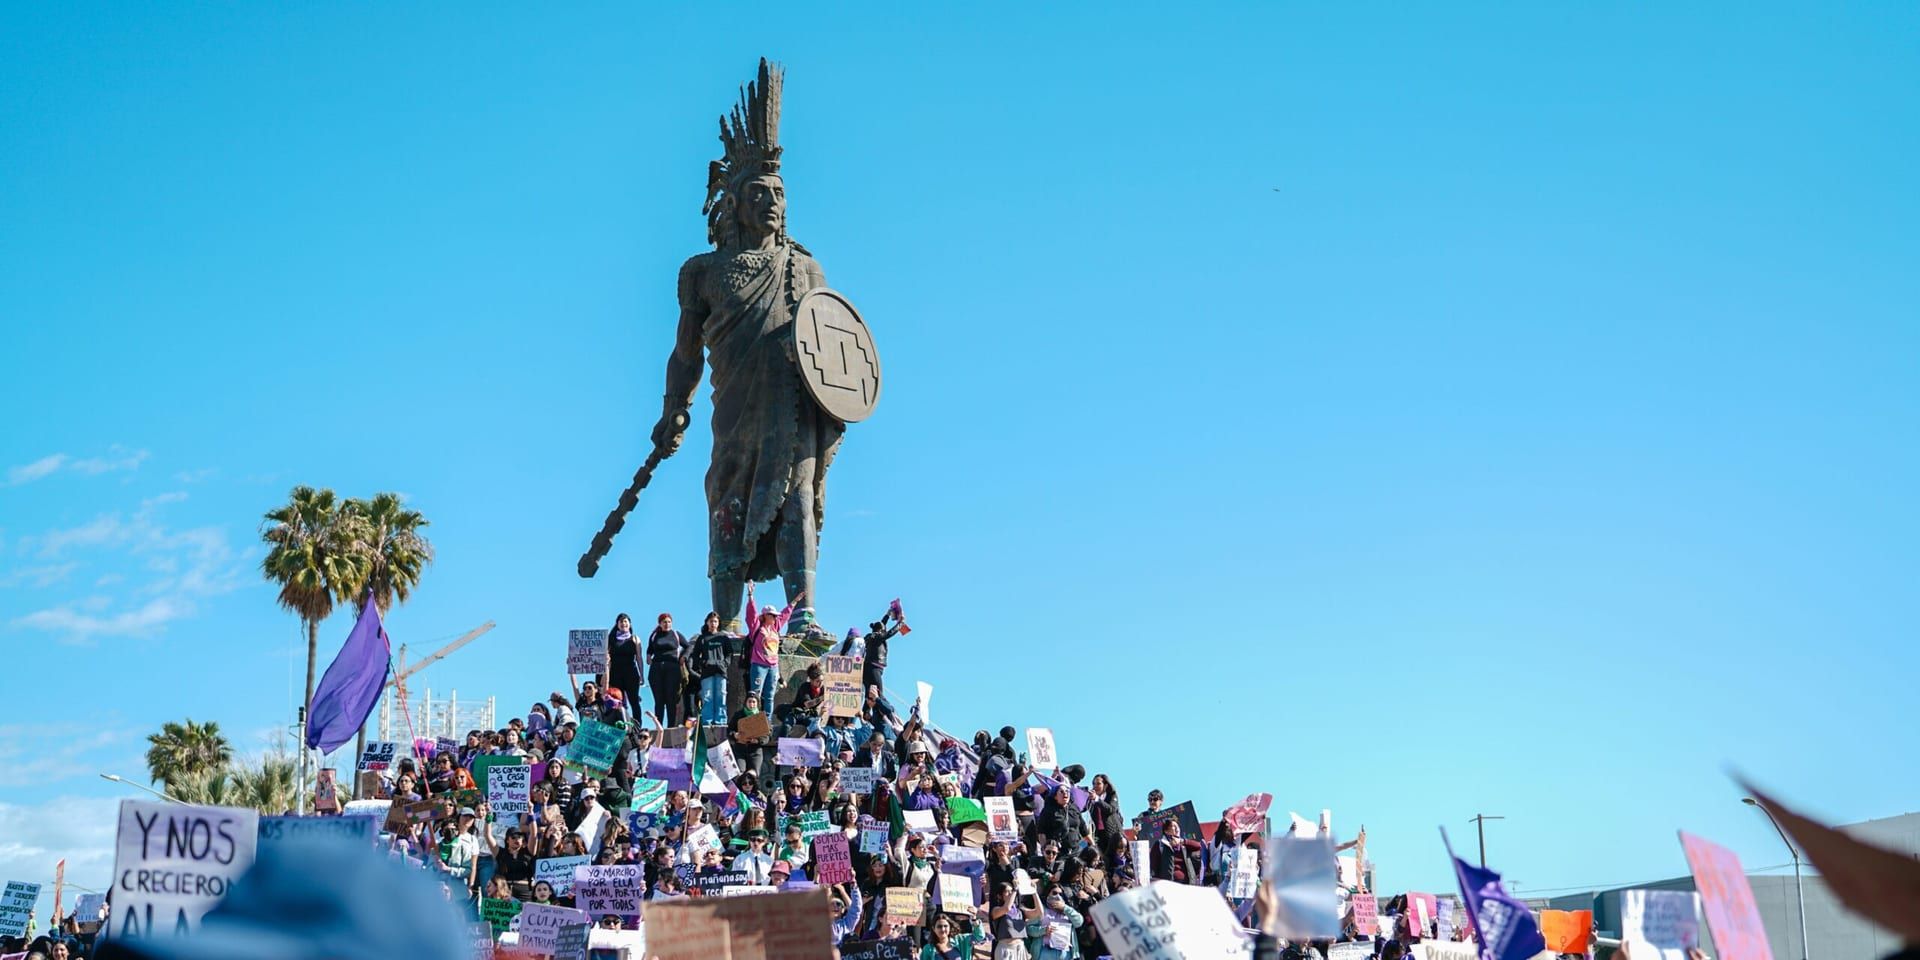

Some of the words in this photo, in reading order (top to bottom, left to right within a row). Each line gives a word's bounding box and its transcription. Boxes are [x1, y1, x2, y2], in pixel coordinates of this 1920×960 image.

[381, 743, 393, 754] ES
[507, 773, 525, 781] casa
[501, 782, 525, 791] quiero
[490, 792, 504, 801] ser
[507, 789, 527, 801] libre
[501, 802, 528, 812] VALIENTE
[135, 810, 158, 861] Y
[166, 815, 235, 865] NOS
[816, 832, 846, 845] SOMOS
[822, 843, 839, 853] MAS
[817, 851, 849, 863] FUERTES
[540, 860, 569, 873] Quiero
[587, 868, 600, 878] YO
[603, 867, 636, 878] MARCHO
[822, 862, 835, 871] QUE
[699, 873, 734, 885] mañana
[735, 873, 748, 886] soy
[820, 869, 853, 884] MIEDO
[588, 878, 607, 888] POR
[613, 878, 634, 888] ELLA
[581, 888, 598, 899] POR
[615, 888, 631, 898] POR
[589, 899, 607, 911] POR
[608, 899, 636, 912] TODAS
[1120, 910, 1172, 946] psicol
[522, 935, 558, 949] PATRIAR
[876, 943, 900, 959] Paz
